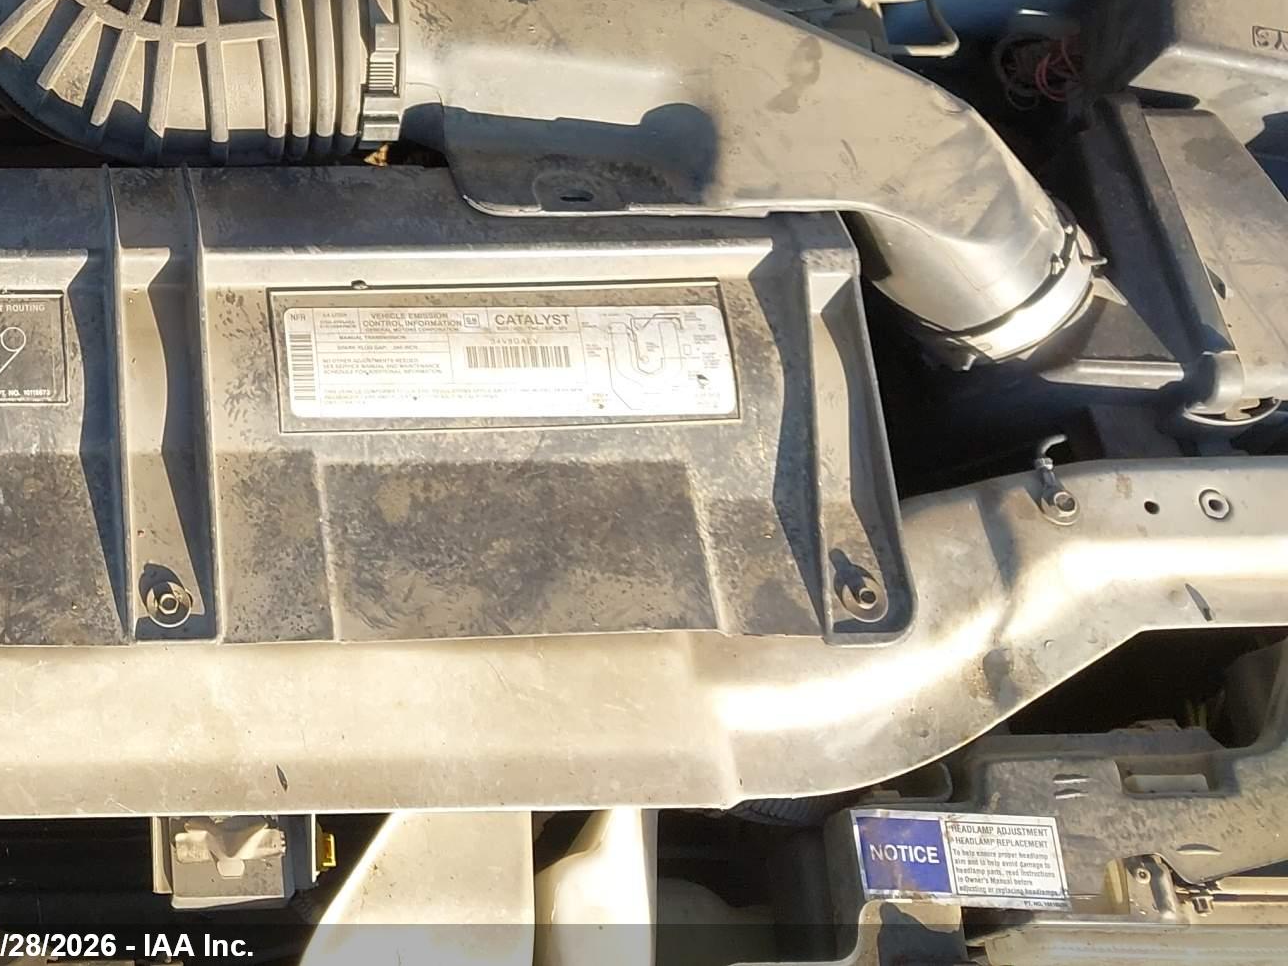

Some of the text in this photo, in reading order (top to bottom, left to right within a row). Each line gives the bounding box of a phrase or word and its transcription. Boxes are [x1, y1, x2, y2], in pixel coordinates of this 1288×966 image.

[6, 304, 46, 312] ROUTING
[370, 312, 449, 320] VEHICLE EMISSION
[495, 314, 570, 326] CATALYST
[951, 824, 1048, 837] HEADLAMP ADJUSTMENT
[955, 836, 1048, 848] HEADLAMP REPLACEMENT
[870, 844, 941, 864] NOTICE
[952, 848, 961, 856] To
[962, 850, 974, 858] help
[998, 852, 1017, 860] proper
[1018, 852, 1049, 862] headlamp
[988, 860, 1001, 868] help
[1002, 860, 1018, 868] avoid
[1020, 862, 1043, 870] damage
[956, 866, 986, 875] headlamp
[987, 868, 1004, 877] parts,
[1020, 870, 1056, 878] instructions
[964, 876, 989, 884] Owner's
[959, 885, 986, 894] adjusting
[996, 888, 1024, 896] replacing
